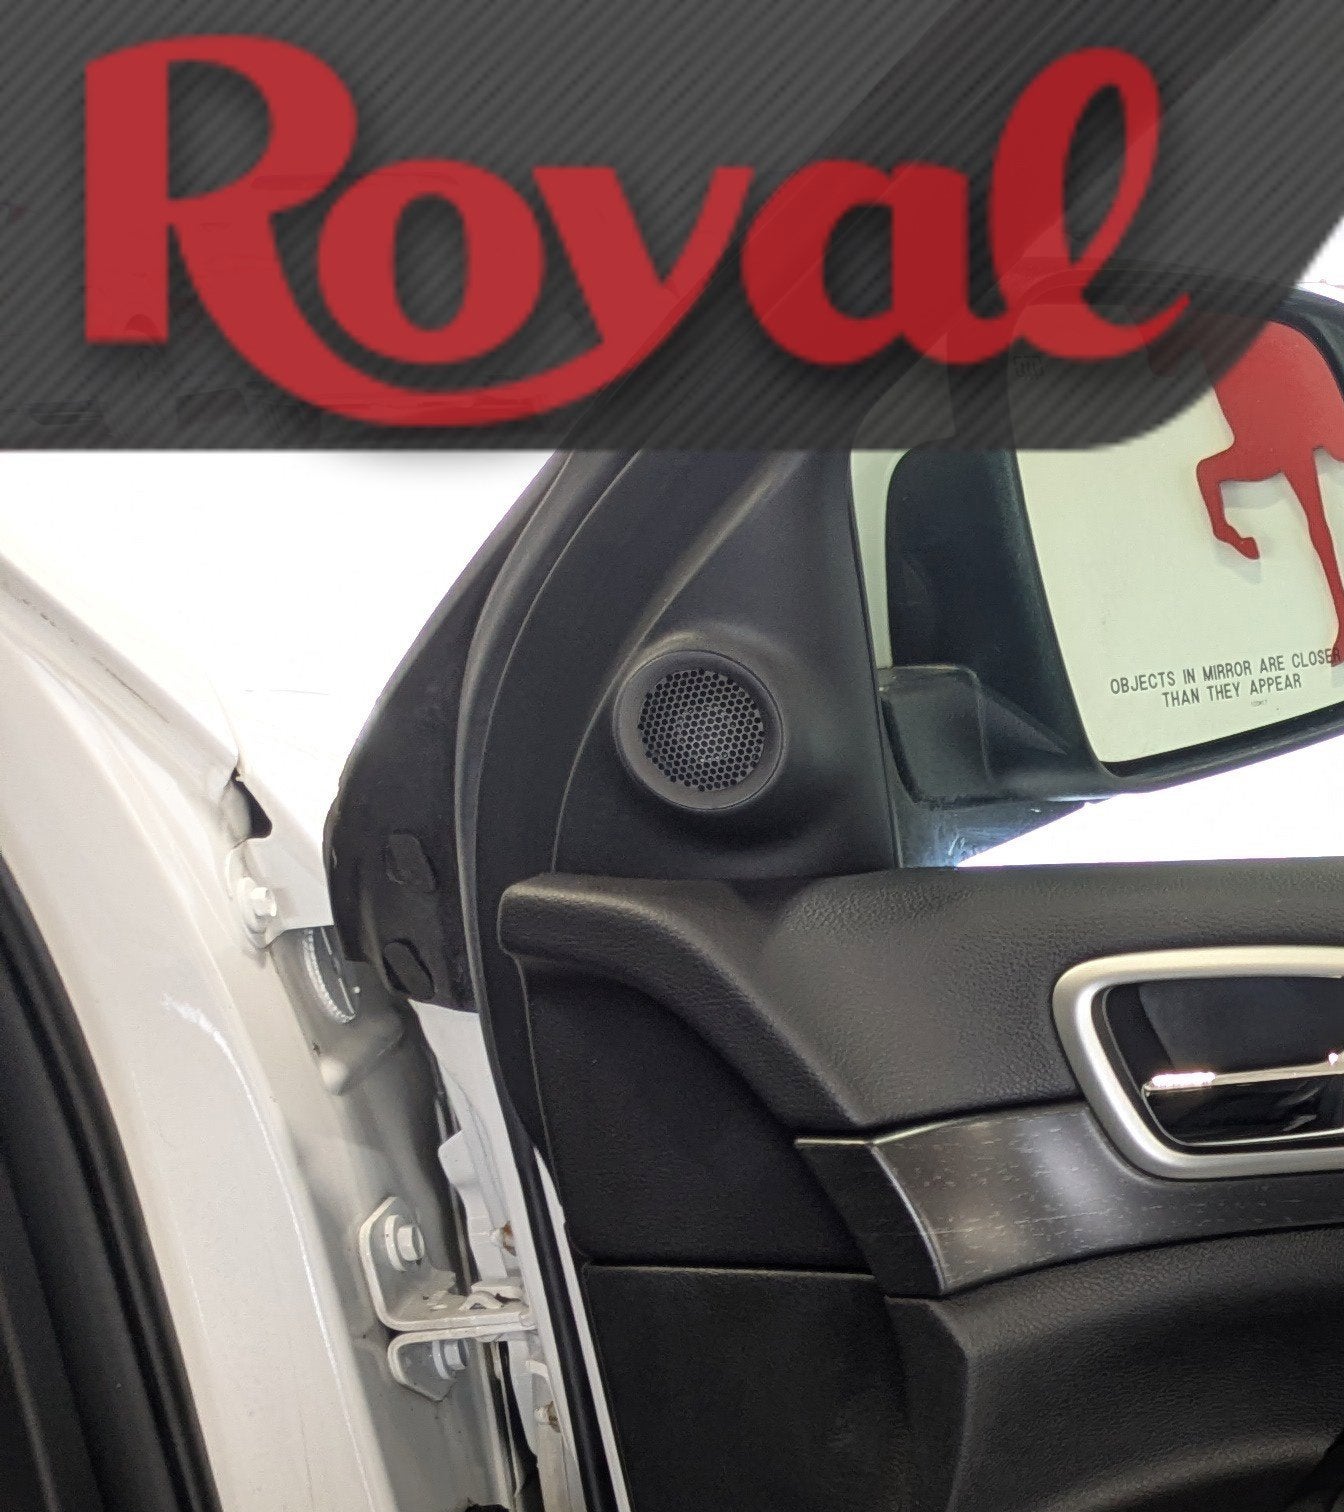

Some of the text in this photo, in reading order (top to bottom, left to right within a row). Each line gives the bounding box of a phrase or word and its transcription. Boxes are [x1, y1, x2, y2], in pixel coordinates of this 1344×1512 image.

[1110, 670, 1176, 695] OBJECTS
[1182, 667, 1196, 685] IN
[1202, 660, 1252, 682] MIRROR
[1259, 654, 1286, 674] ARE
[1161, 673, 1302, 708] THAN THEY APPEAR
